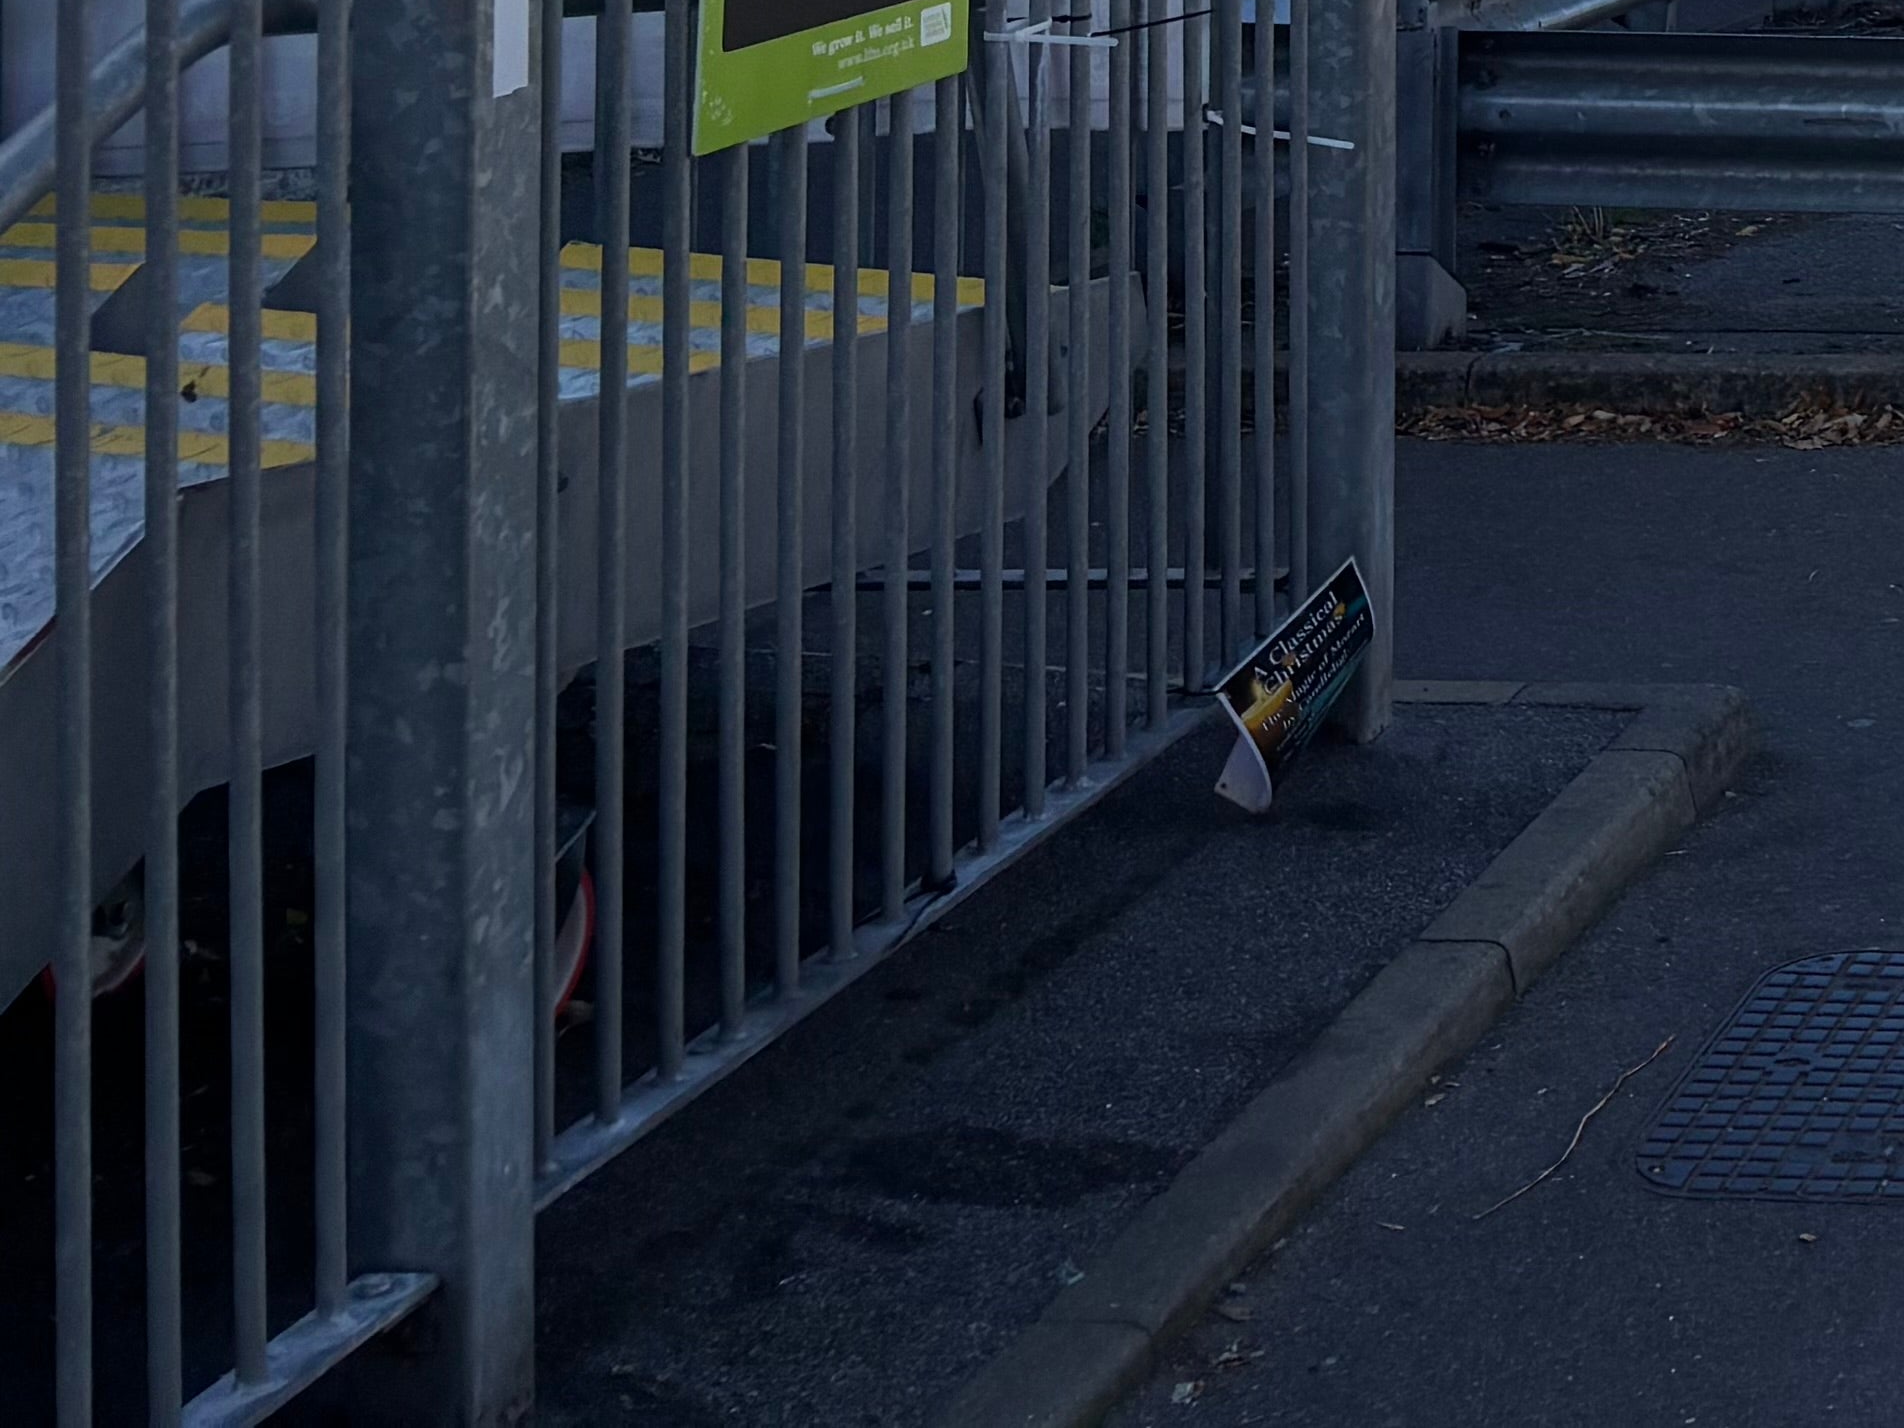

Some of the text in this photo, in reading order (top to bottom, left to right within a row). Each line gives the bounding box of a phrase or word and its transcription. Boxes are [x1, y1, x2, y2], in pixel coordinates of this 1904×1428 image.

[1253, 665, 1268, 680] A
[1268, 590, 1339, 666] Classical
[1263, 614, 1344, 695] Christmas
